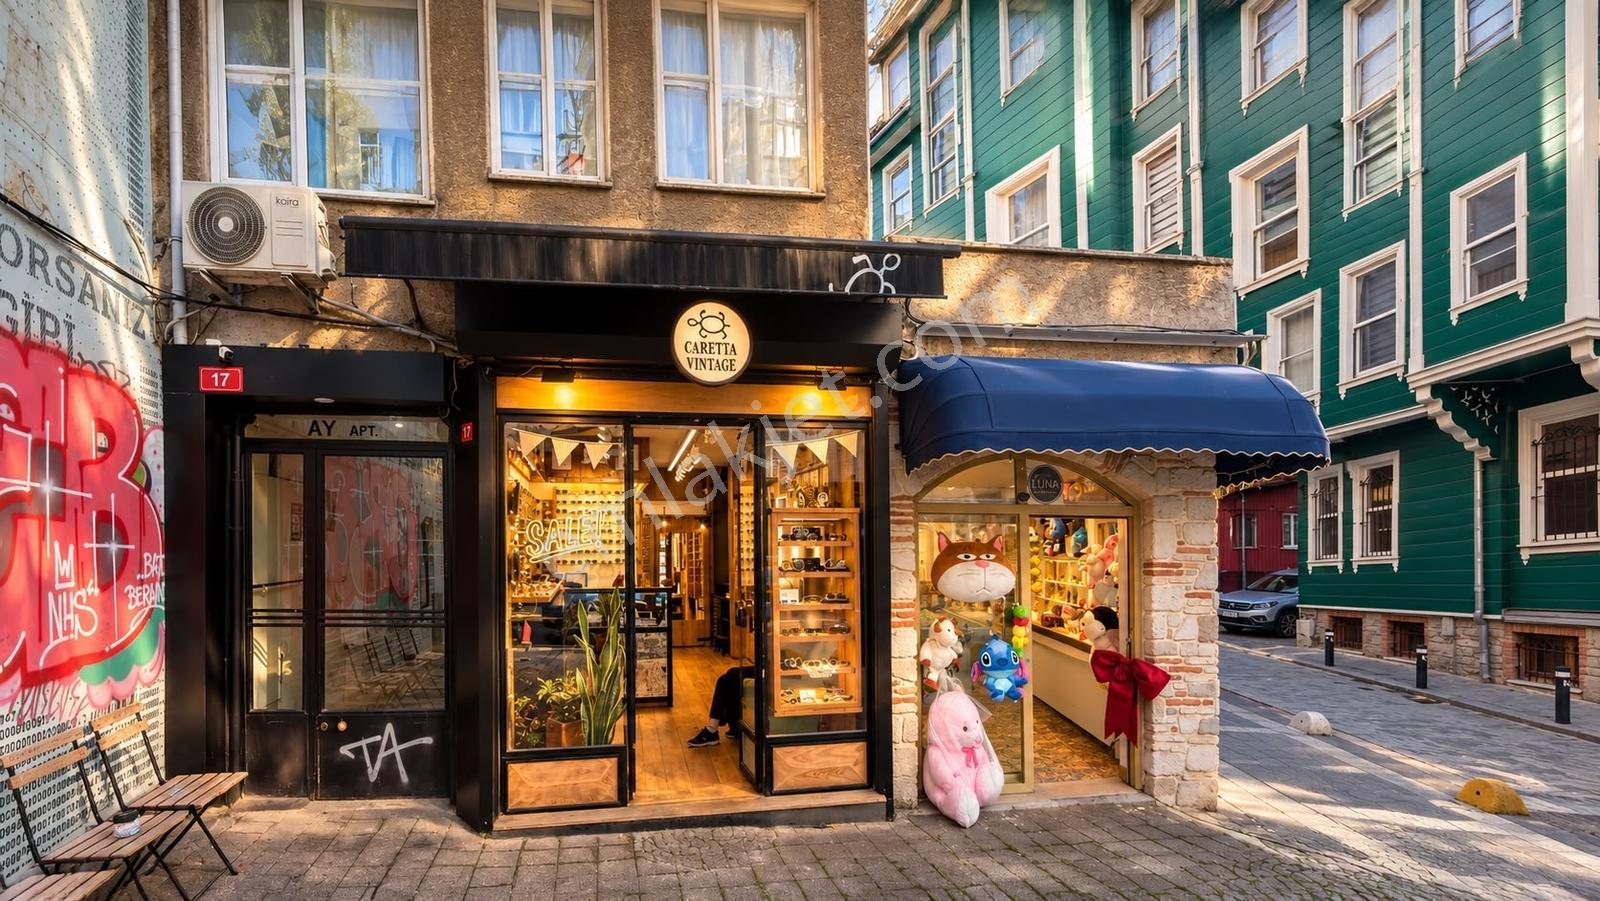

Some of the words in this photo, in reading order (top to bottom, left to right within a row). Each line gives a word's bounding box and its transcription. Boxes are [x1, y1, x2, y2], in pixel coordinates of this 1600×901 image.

[684, 340, 737, 356] CARETTA
[686, 357, 737, 372] VINTAGE
[211, 373, 230, 388] 17
[308, 420, 336, 437] AY
[350, 425, 379, 437] APT.
[462, 425, 471, 439] 17
[1031, 478, 1060, 489] LUNA
[525, 510, 606, 559] SALE!
[339, 722, 434, 782] TA
